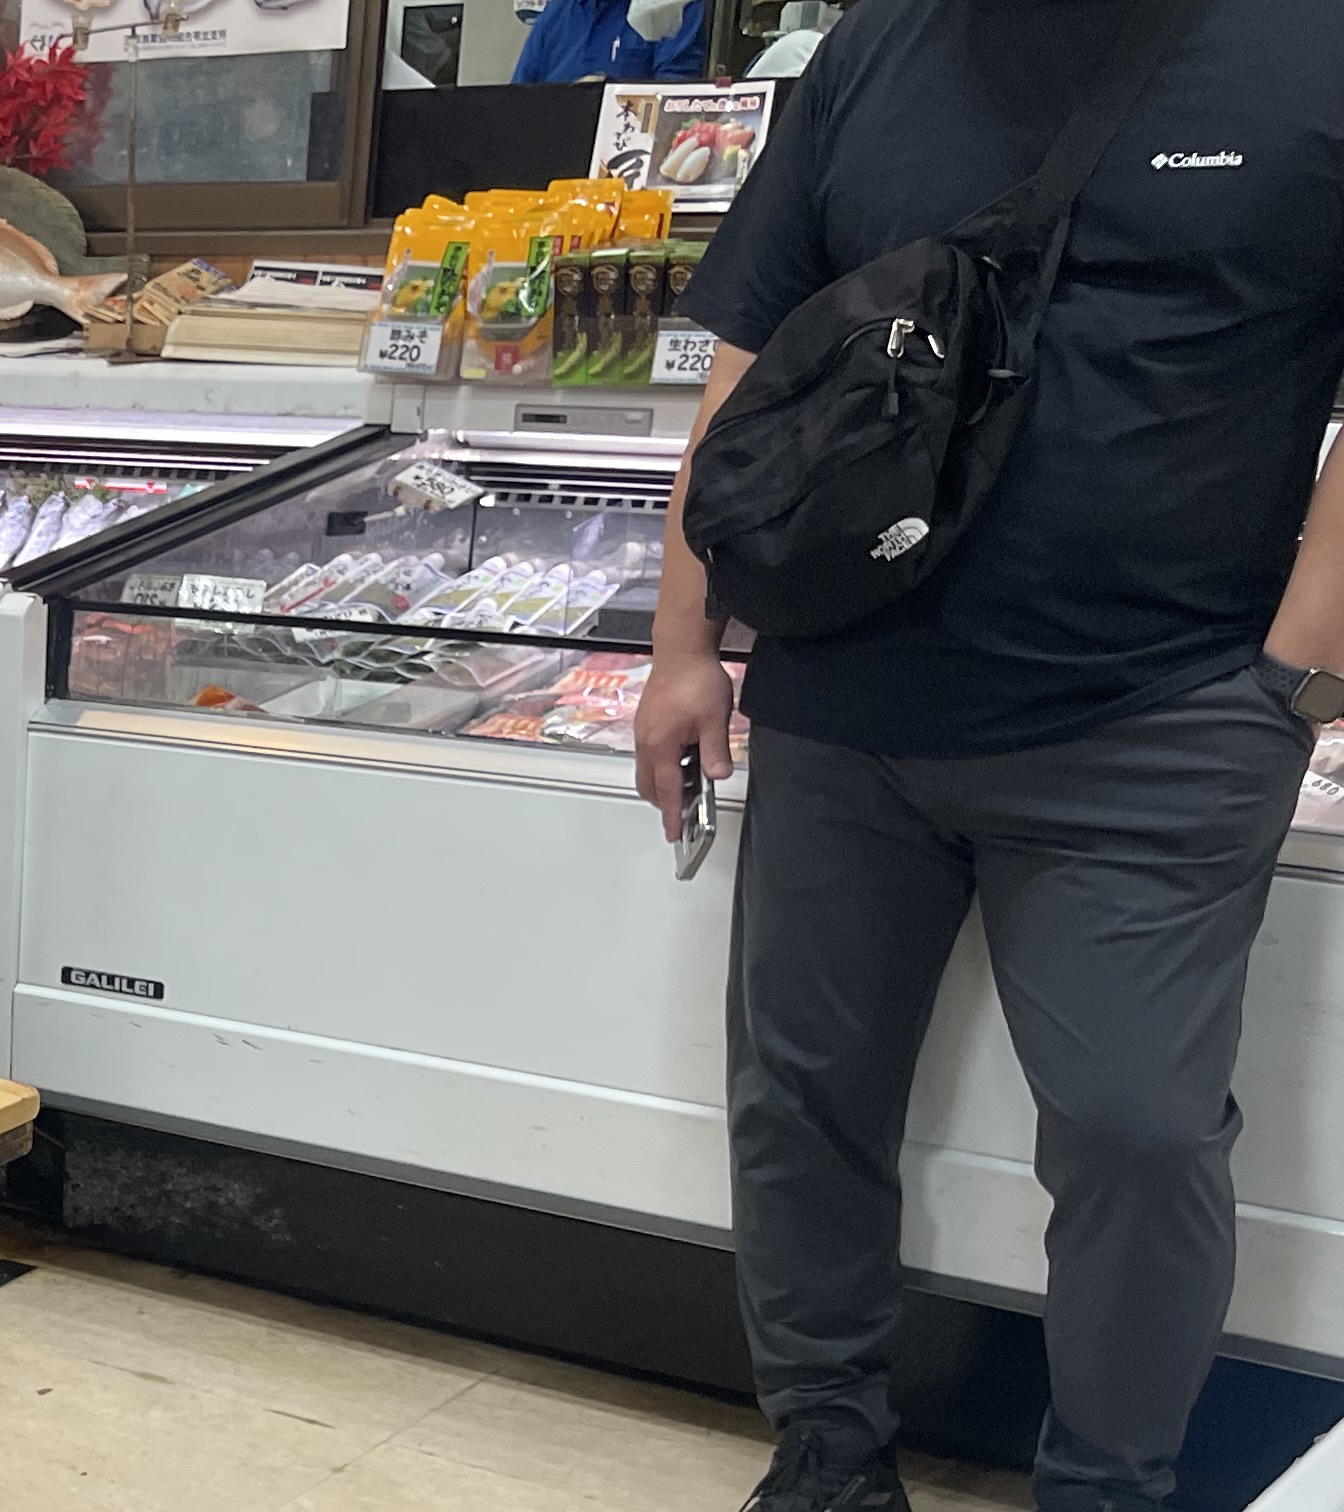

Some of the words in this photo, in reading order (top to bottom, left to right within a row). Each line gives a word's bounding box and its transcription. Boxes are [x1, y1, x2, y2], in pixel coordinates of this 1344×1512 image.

[1168, 151, 1244, 168] Columbia
[379, 343, 421, 362] ¥220
[668, 339, 717, 352] 生わさ
[665, 354, 712, 371] ¥220
[70, 969, 155, 997] GALILEI
